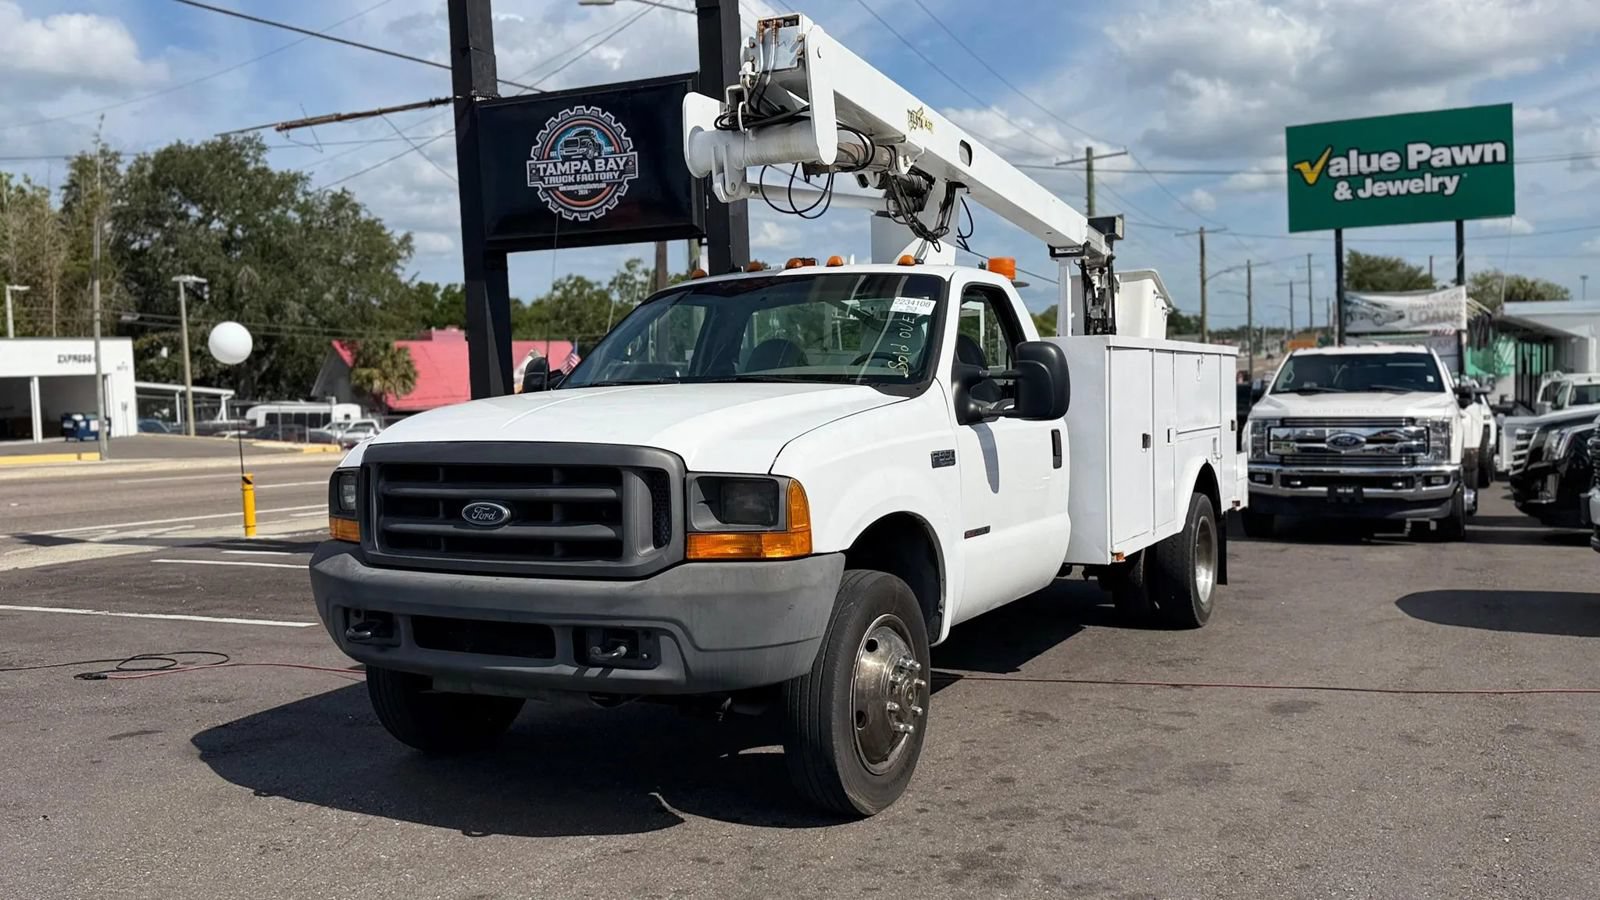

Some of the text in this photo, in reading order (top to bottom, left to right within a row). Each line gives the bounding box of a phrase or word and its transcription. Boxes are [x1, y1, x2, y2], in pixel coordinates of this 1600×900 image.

[1407, 141, 1507, 170] Pawn
[536, 157, 628, 177] TAMPA BAY
[543, 171, 621, 185] TRUCK FACTORY
[1333, 173, 1460, 201] & Jewelry
[1409, 310, 1463, 323] LOANS
[887, 343, 911, 378] Sold
[471, 506, 497, 521] Ford
